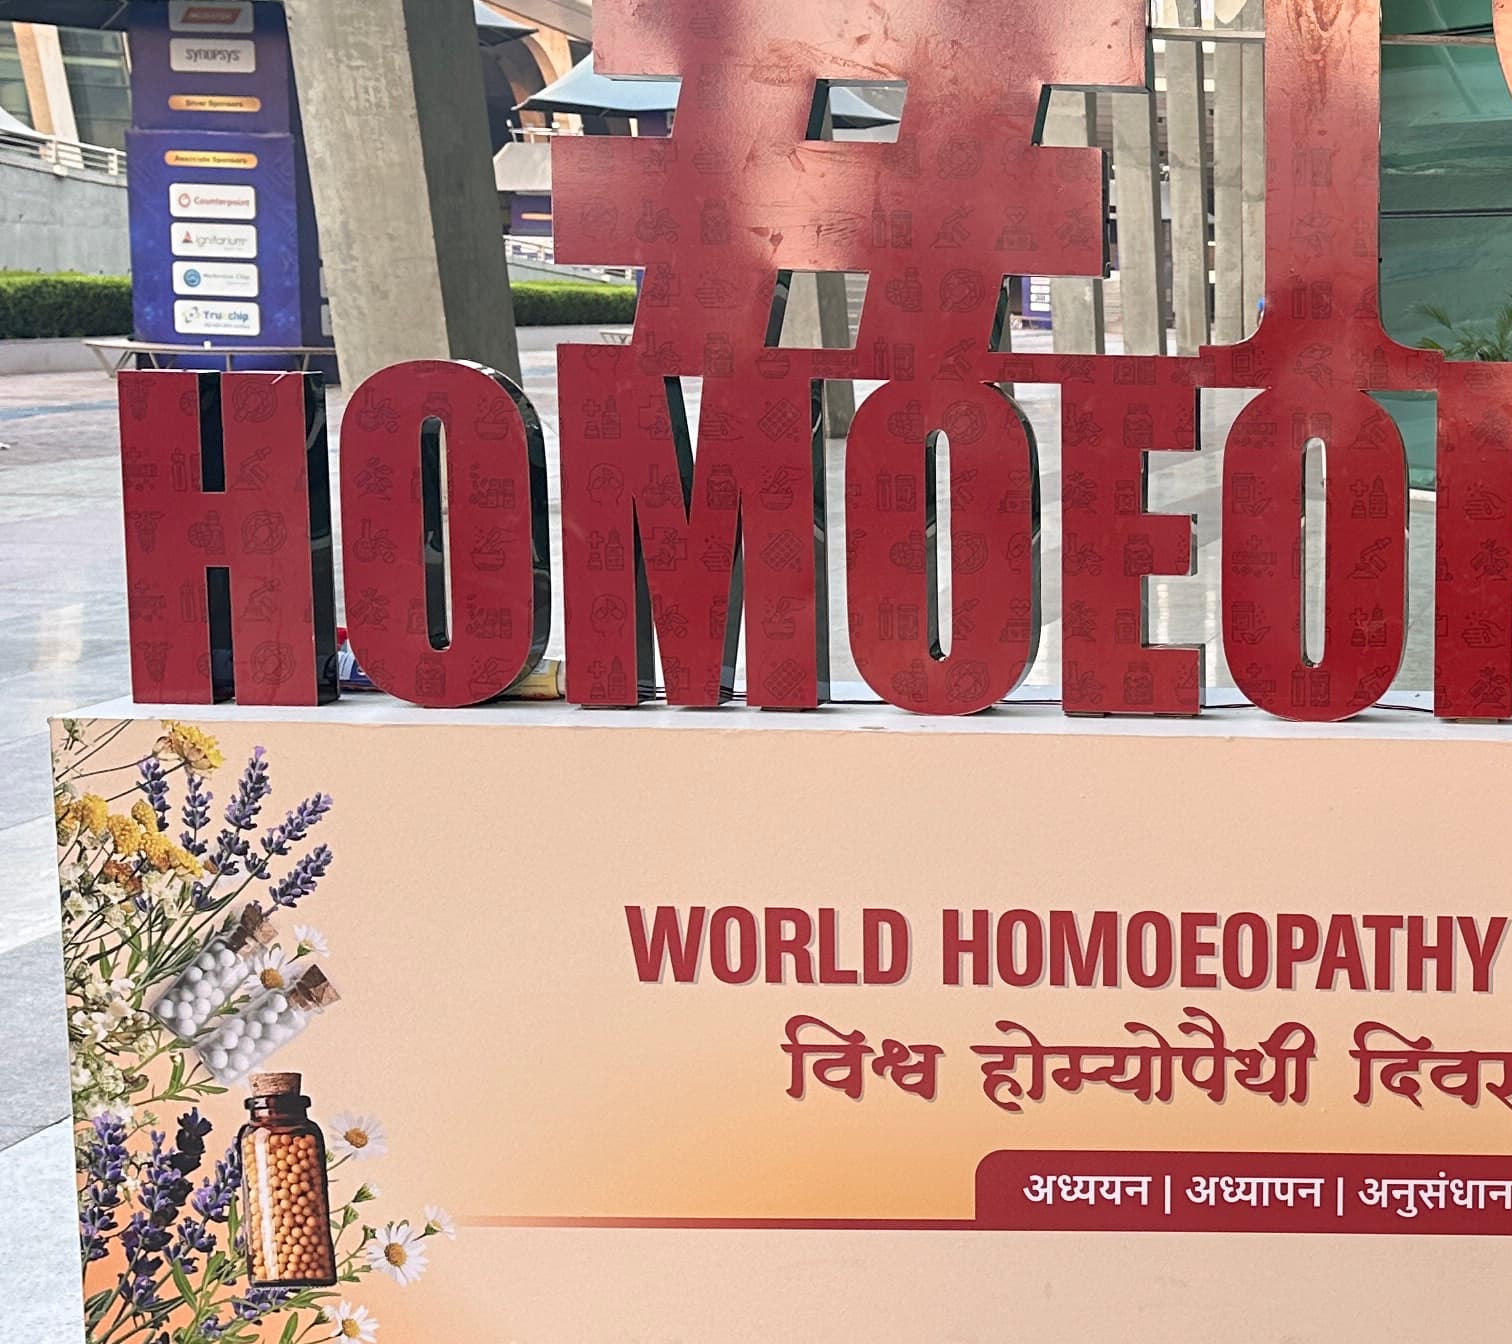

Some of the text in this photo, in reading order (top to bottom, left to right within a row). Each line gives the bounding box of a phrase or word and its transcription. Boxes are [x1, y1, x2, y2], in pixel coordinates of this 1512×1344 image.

[624, 905, 911, 987] WORLD
[942, 908, 1511, 995] HOMOEOPATHY
[781, 1014, 944, 1100] विश्व
[970, 1006, 1317, 1112] होम्योपैथी
[1022, 1174, 1152, 1206] अध्ययन
[1185, 1175, 1325, 1208] अध्यापन
